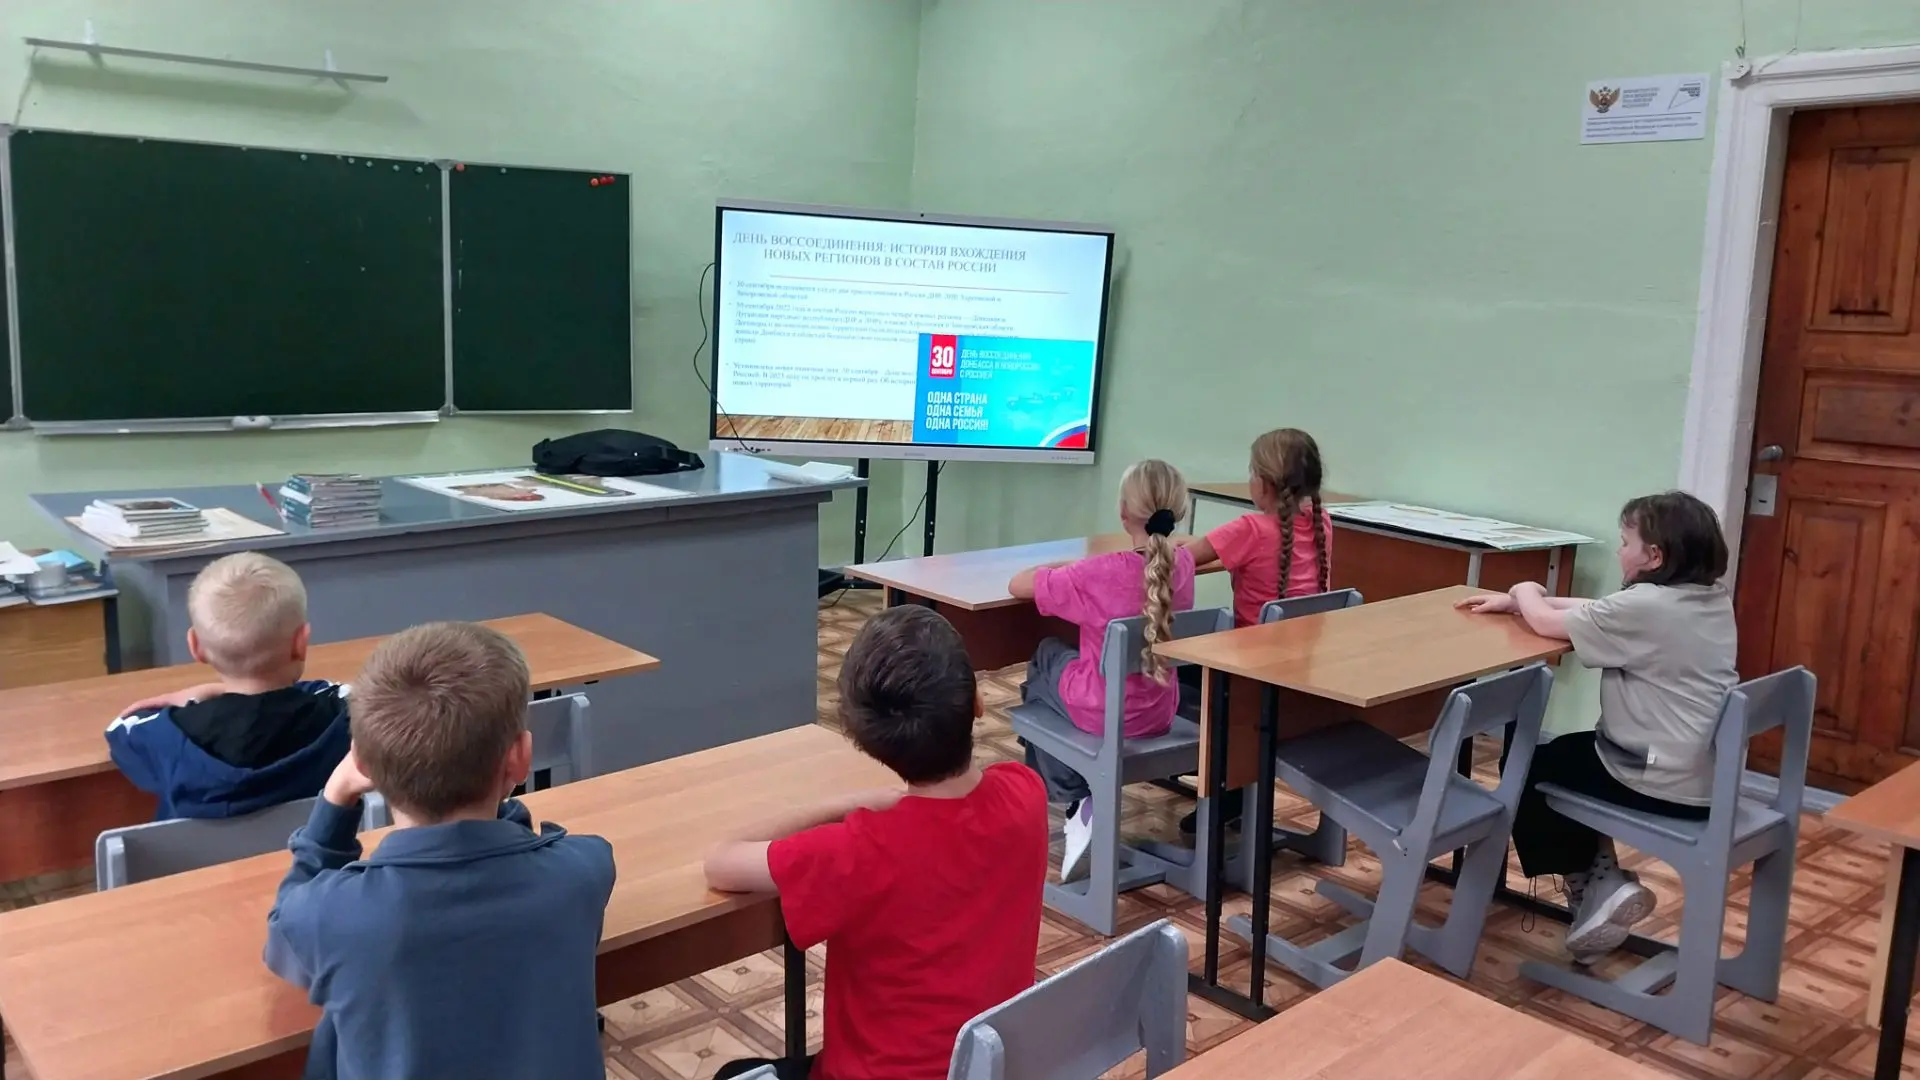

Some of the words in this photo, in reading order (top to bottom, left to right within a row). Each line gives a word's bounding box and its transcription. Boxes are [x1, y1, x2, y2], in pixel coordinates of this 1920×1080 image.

[733, 231, 768, 245] ДЕНЬ
[771, 234, 888, 252] ВОССОЕДИНЕНИЯ:
[890, 242, 947, 257] ИСТОРИЯ
[950, 246, 1027, 262] ВХОЖДЕНИЯ
[764, 248, 811, 262] НОВЫХ
[814, 251, 881, 266] РЕГИОНОВ
[884, 256, 892, 267] В
[895, 257, 945, 270] СОСТАВ
[947, 260, 998, 274] РОССИИ
[931, 345, 954, 367] 30
[961, 349, 978, 359] ДЕНЬ
[960, 359, 993, 370] ДОНБАССА
[928, 391, 952, 404] ОДНА
[954, 392, 989, 405] СТРАНА
[926, 404, 952, 417] ОДНА
[953, 405, 983, 418] СЕМЬЯ
[925, 417, 951, 430] ОДНА
[952, 418, 990, 431] РОССИЯ!
